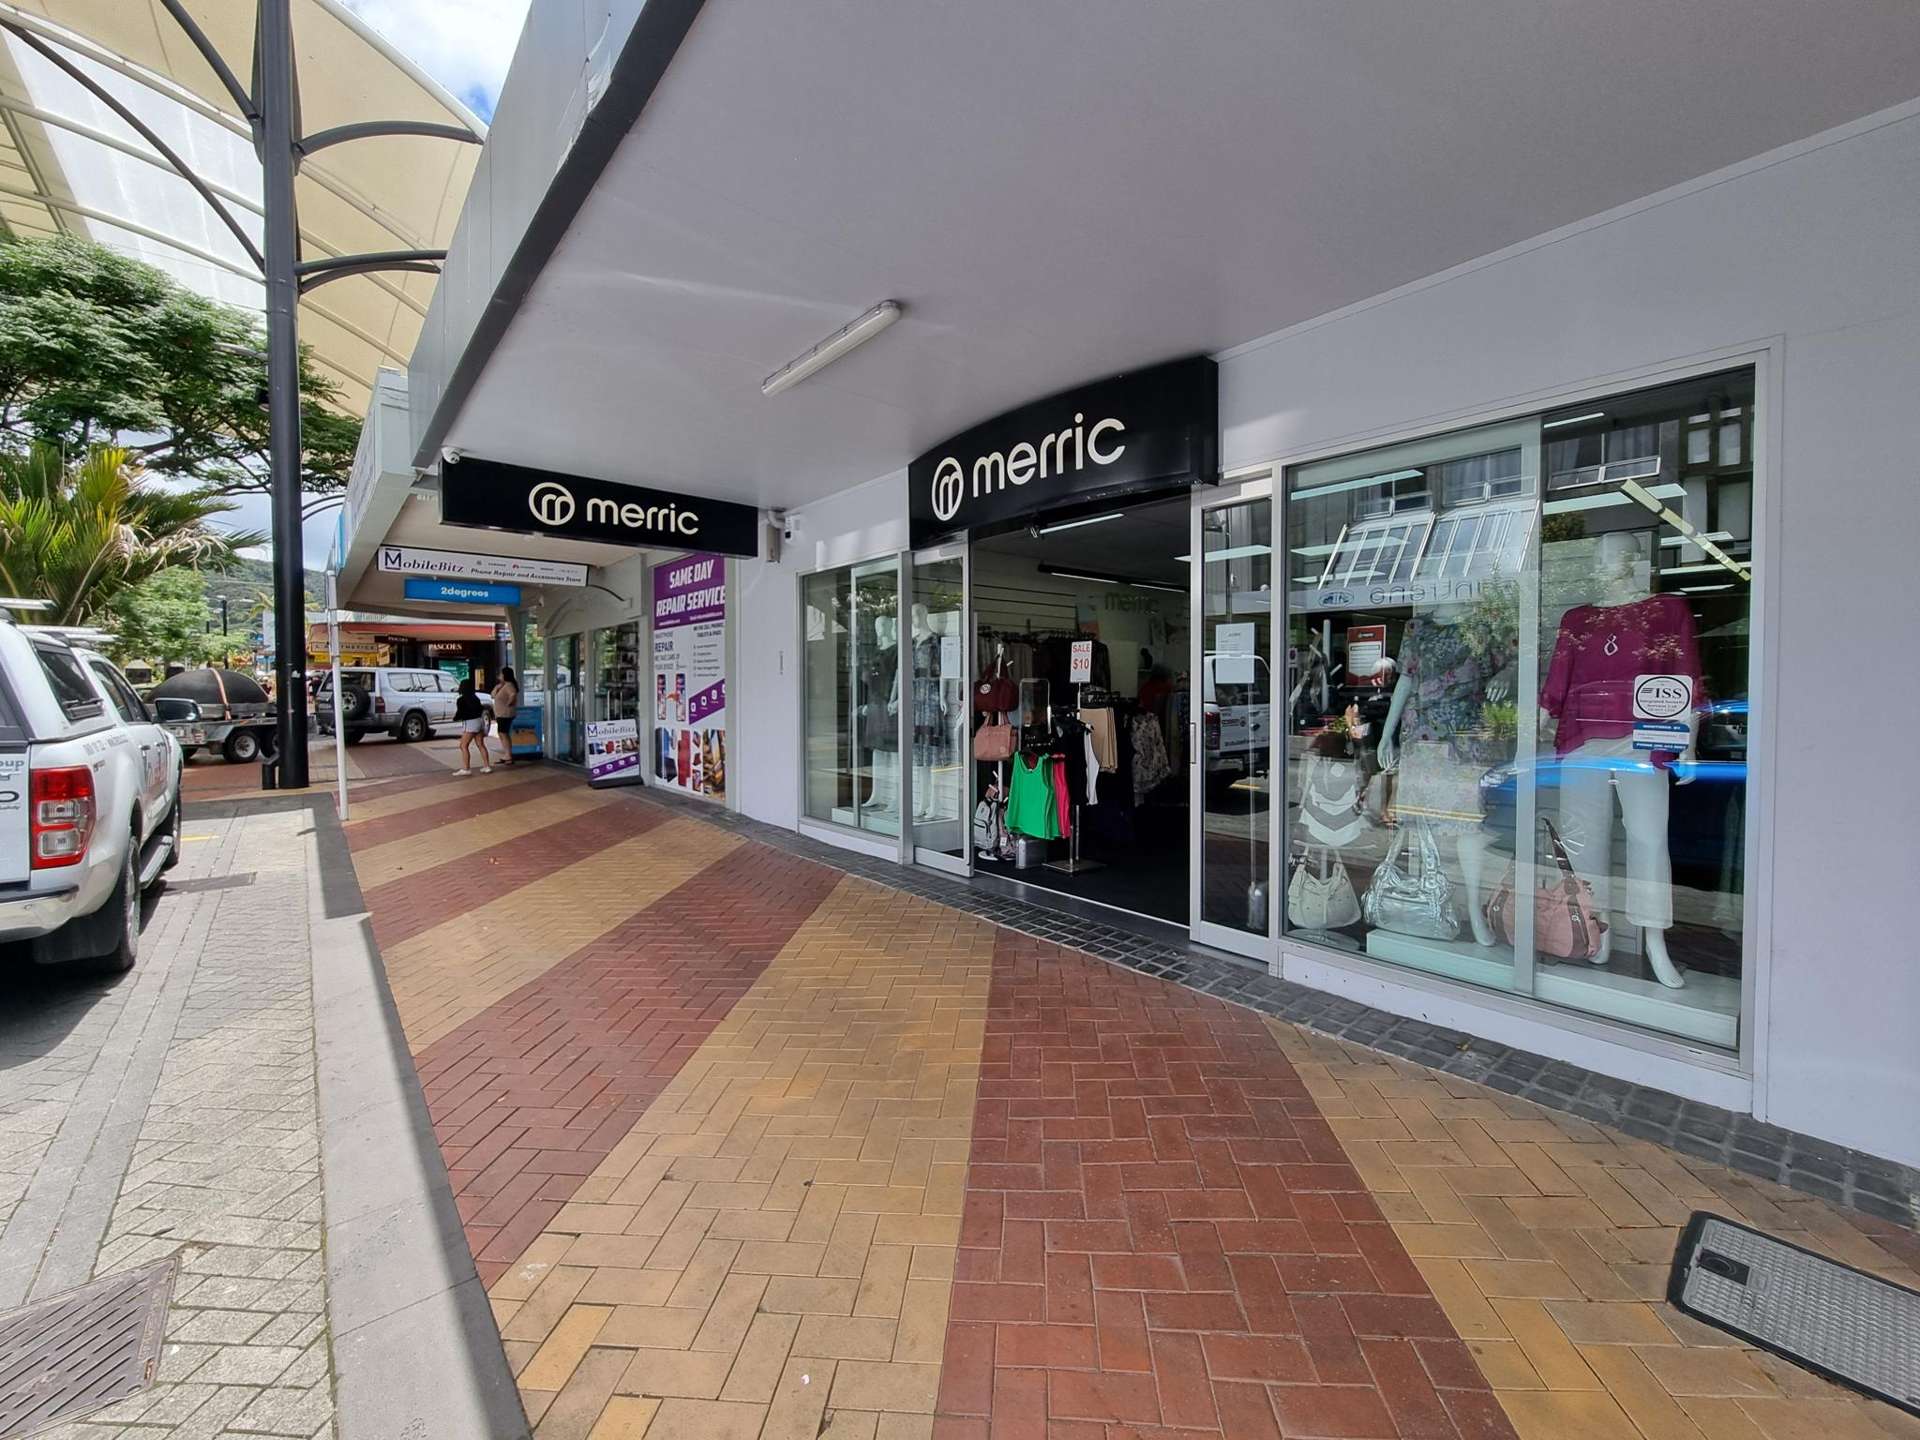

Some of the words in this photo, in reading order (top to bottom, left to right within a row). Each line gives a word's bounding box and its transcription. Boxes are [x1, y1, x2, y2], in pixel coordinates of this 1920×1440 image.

[972, 411, 1127, 498] merric
[586, 496, 700, 536] merric
[669, 565, 694, 589] SAME
[693, 558, 715, 584] DAY
[440, 586, 490, 599] 2degrees
[656, 595, 687, 617] REPAIR
[686, 585, 726, 611] SERVICE
[1072, 643, 1091, 653] SALE
[1655, 687, 1683, 699] ISS
